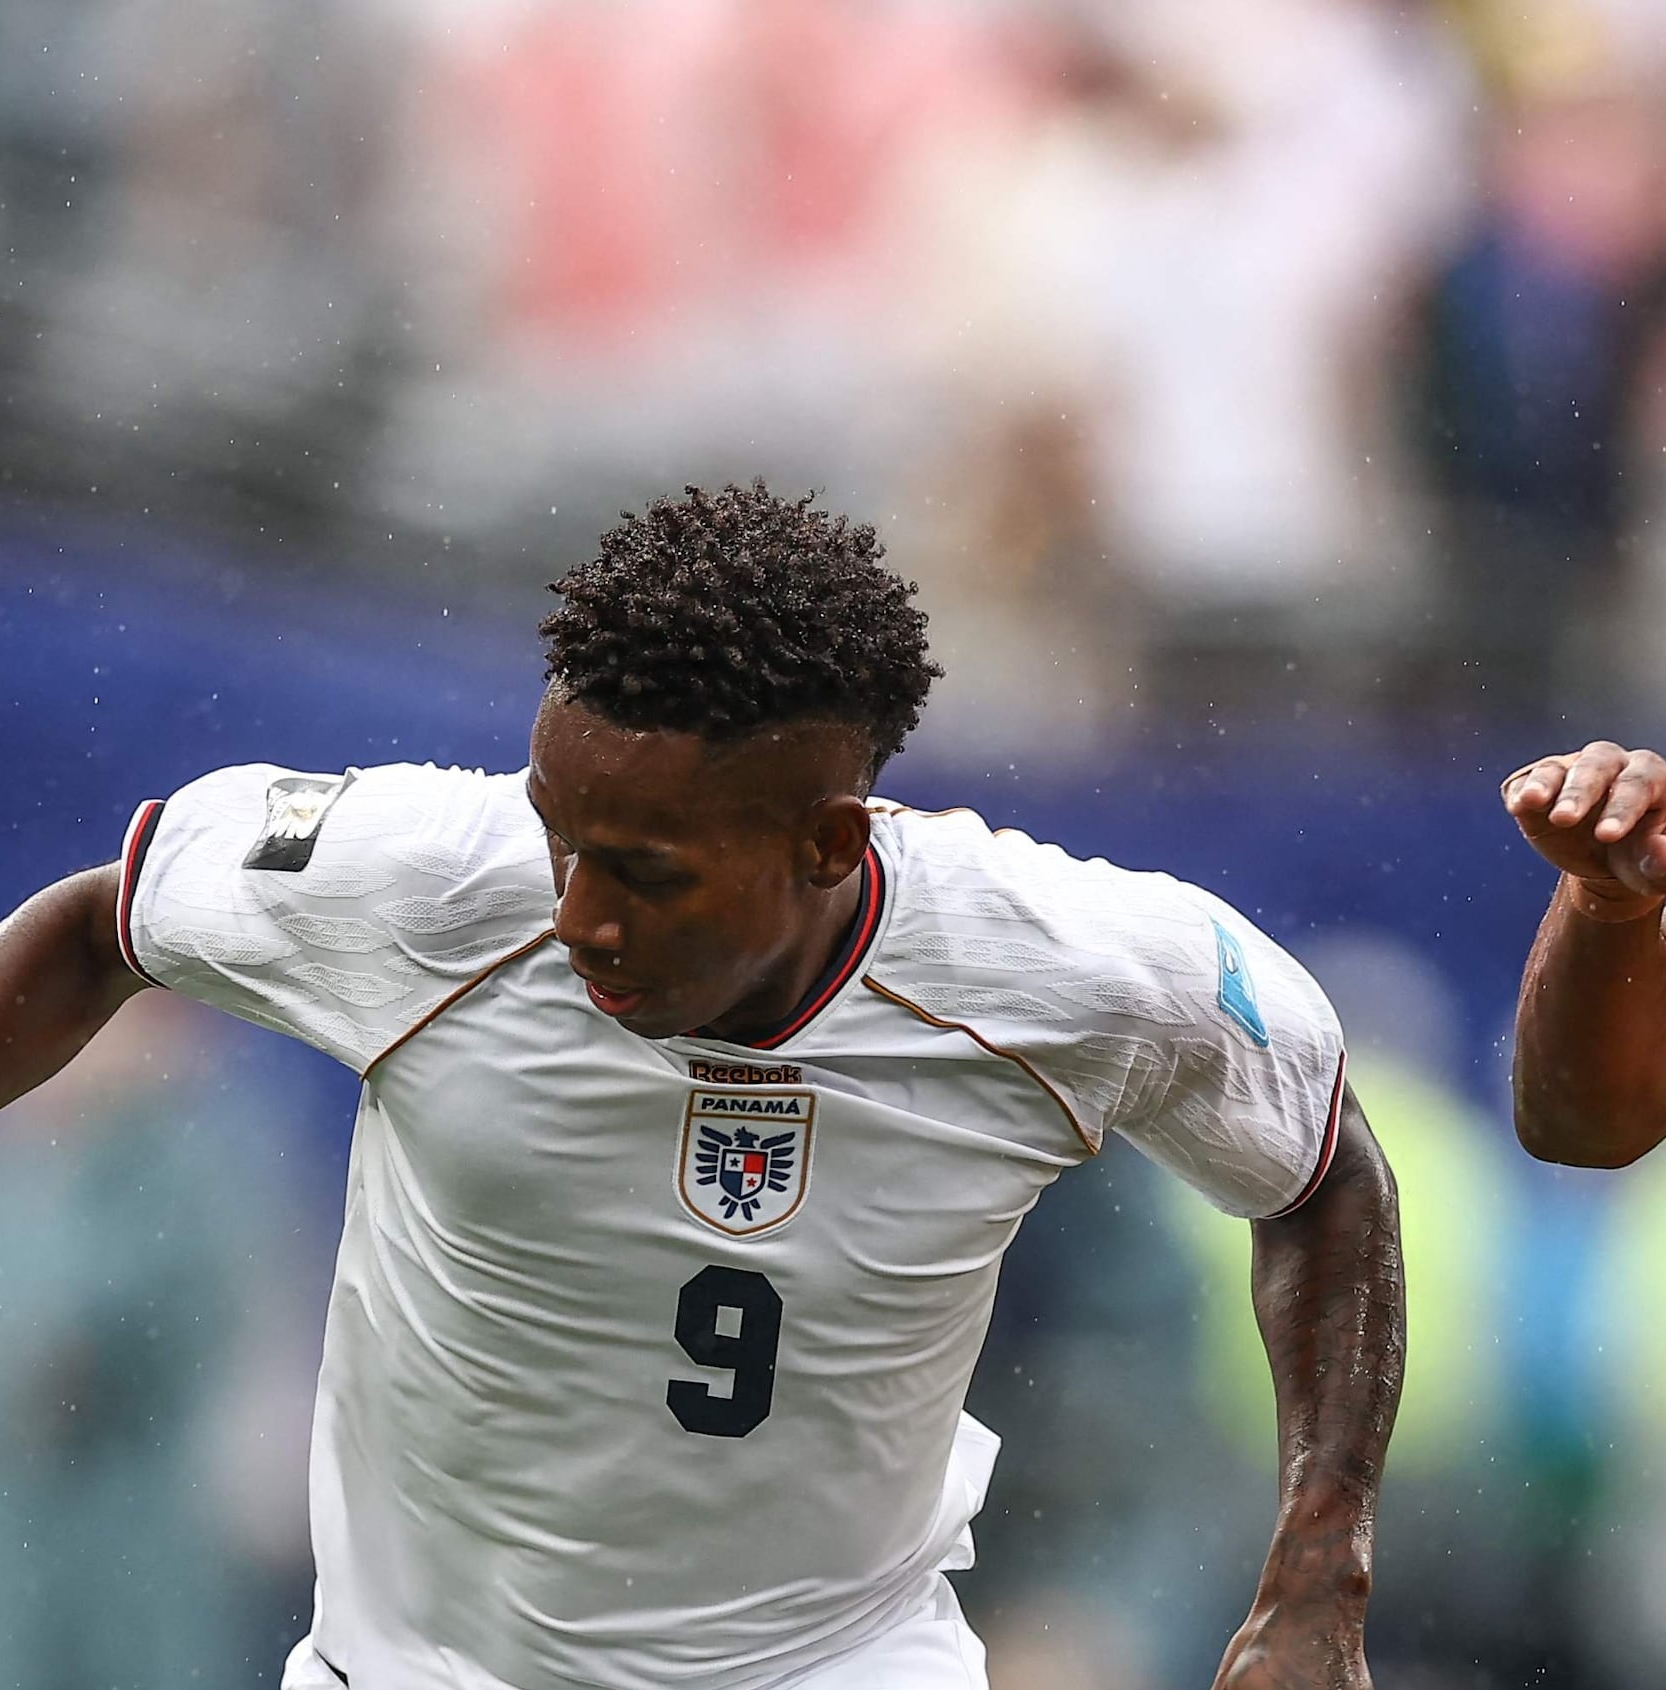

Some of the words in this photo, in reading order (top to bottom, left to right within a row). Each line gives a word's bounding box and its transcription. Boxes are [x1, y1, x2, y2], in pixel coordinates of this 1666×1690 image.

[689, 1060, 803, 1085] Reebok
[701, 1098, 801, 1116] PANAMÁ
[666, 1264, 783, 1439] 9
